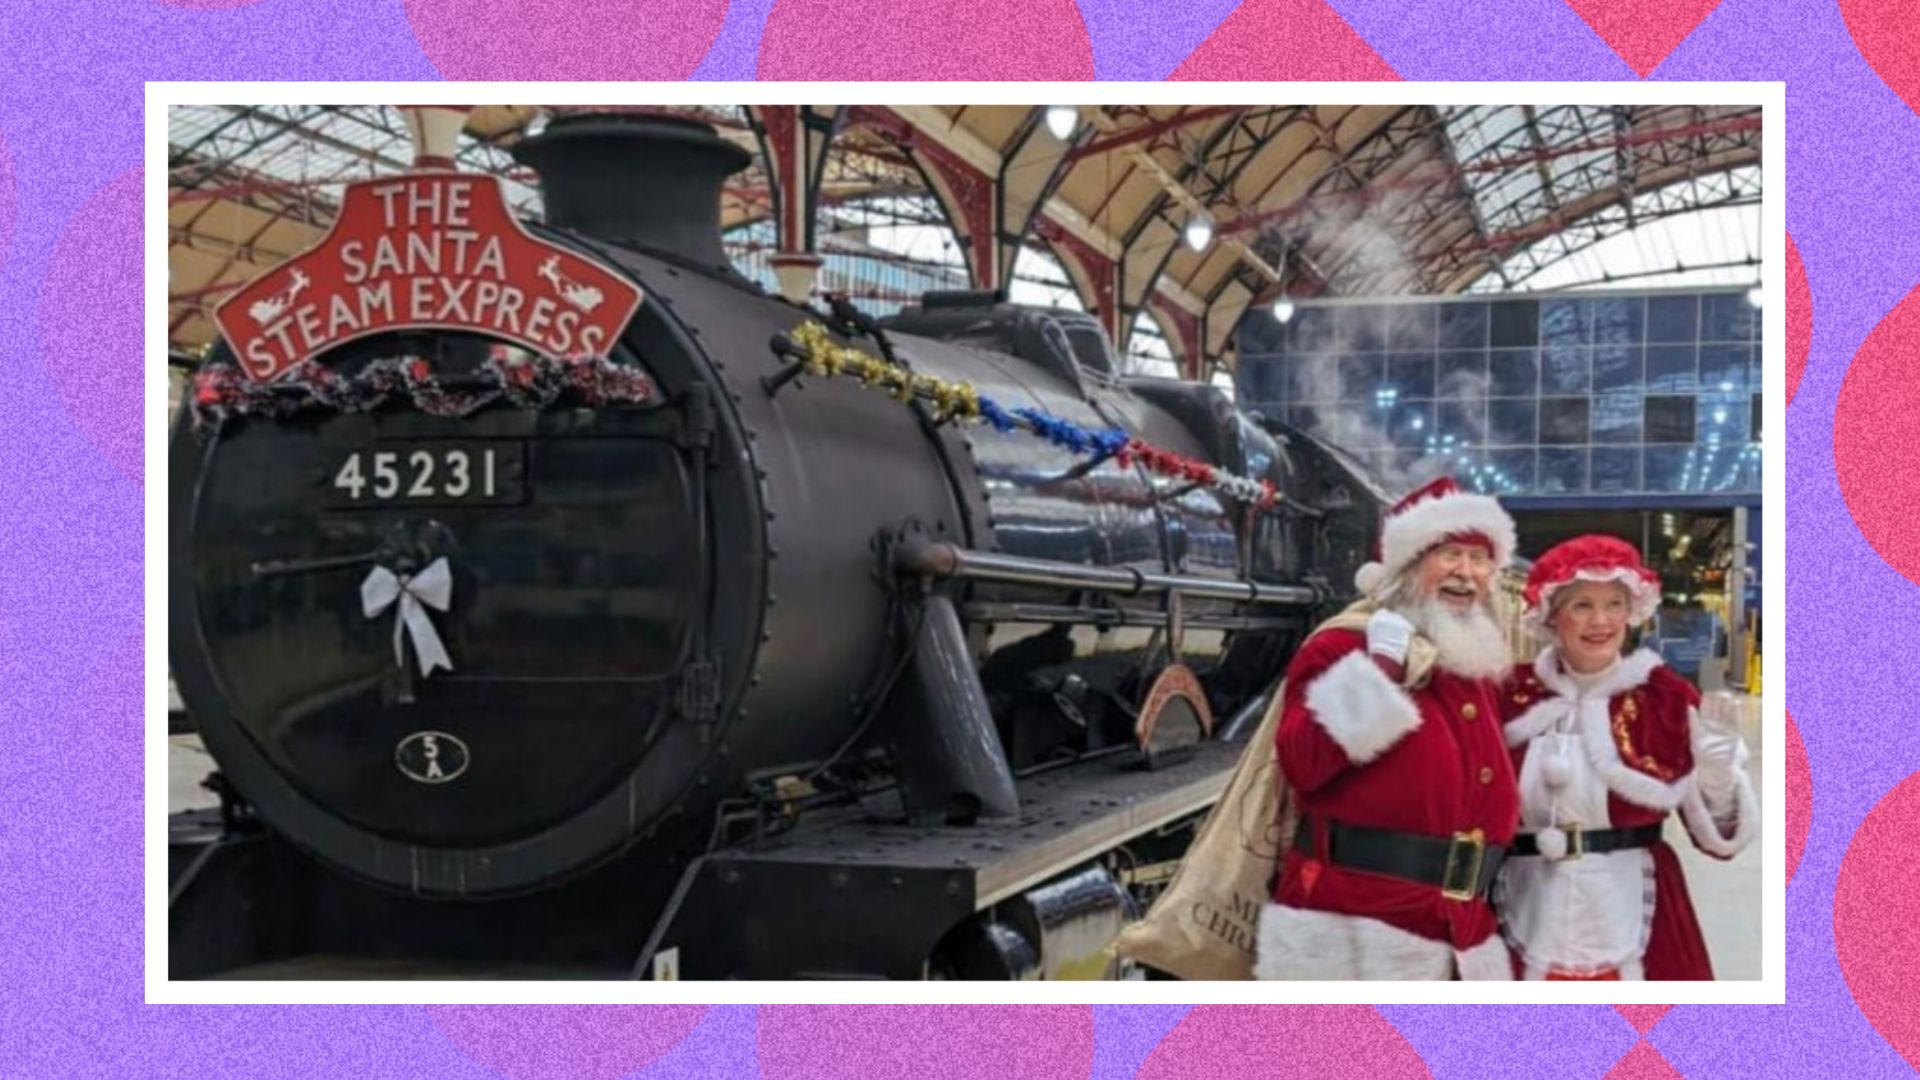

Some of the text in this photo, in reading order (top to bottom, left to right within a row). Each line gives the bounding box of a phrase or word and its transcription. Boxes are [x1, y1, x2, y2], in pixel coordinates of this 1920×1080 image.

[373, 181, 472, 228] THE
[341, 231, 507, 284] SANTA
[247, 277, 604, 377] STEAM EXPRESS
[335, 450, 494, 498] 45231
[423, 735, 439, 759] 5
[426, 760, 444, 779] A
